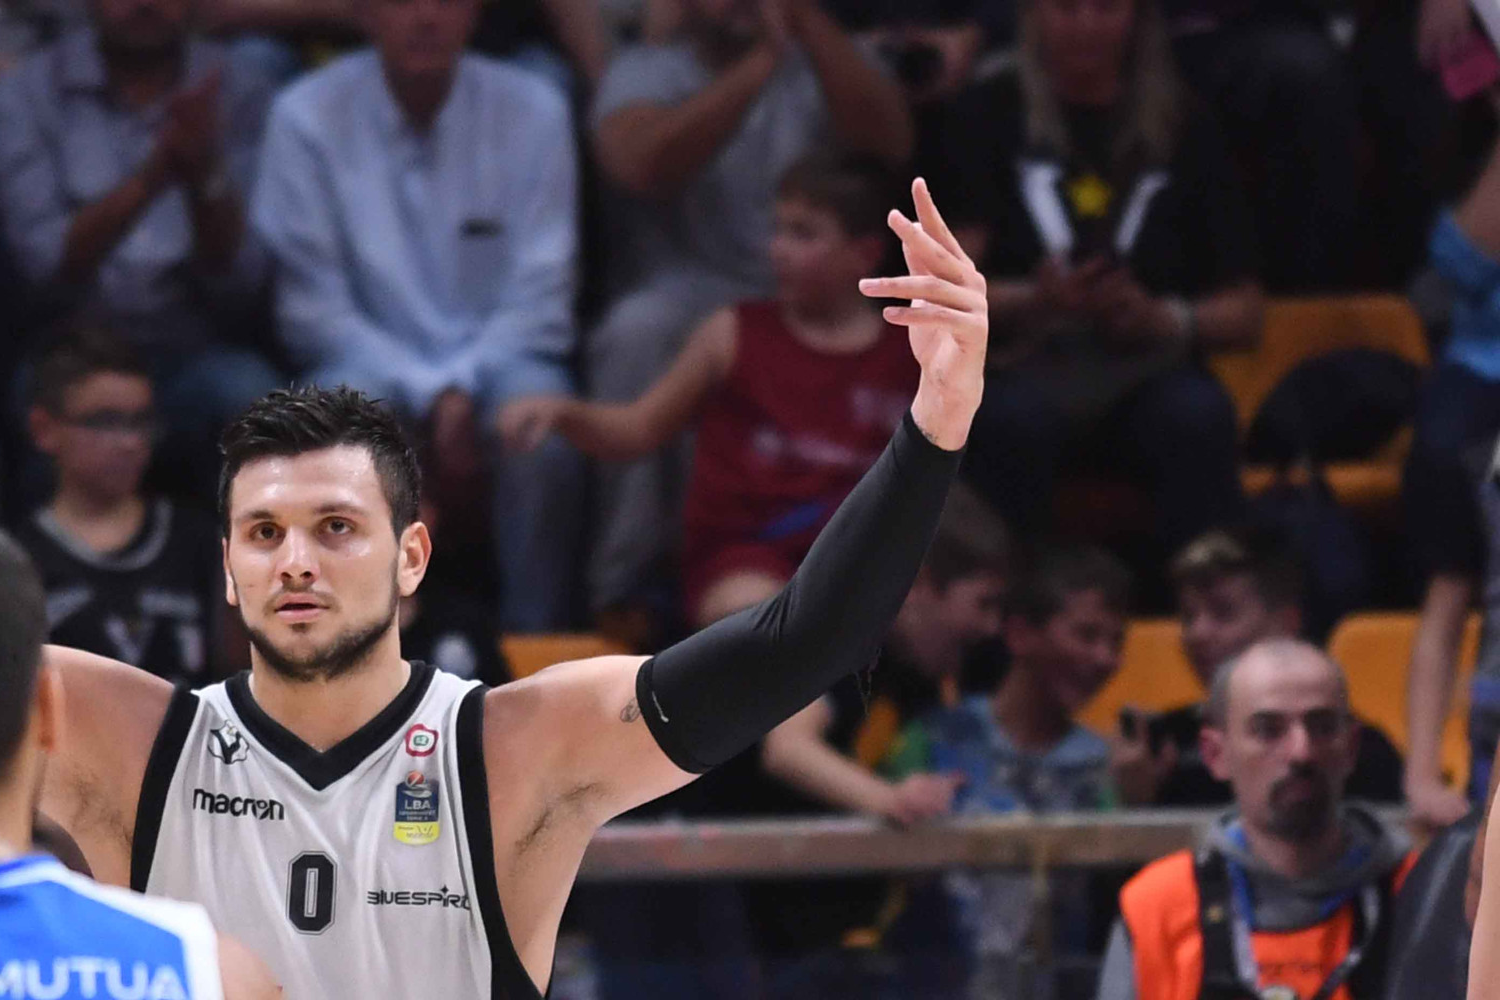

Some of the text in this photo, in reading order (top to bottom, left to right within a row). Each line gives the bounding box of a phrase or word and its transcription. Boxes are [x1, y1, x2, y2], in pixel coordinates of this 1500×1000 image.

[193, 788, 285, 820] macron
[404, 799, 431, 810] LBA
[287, 850, 337, 935] 0
